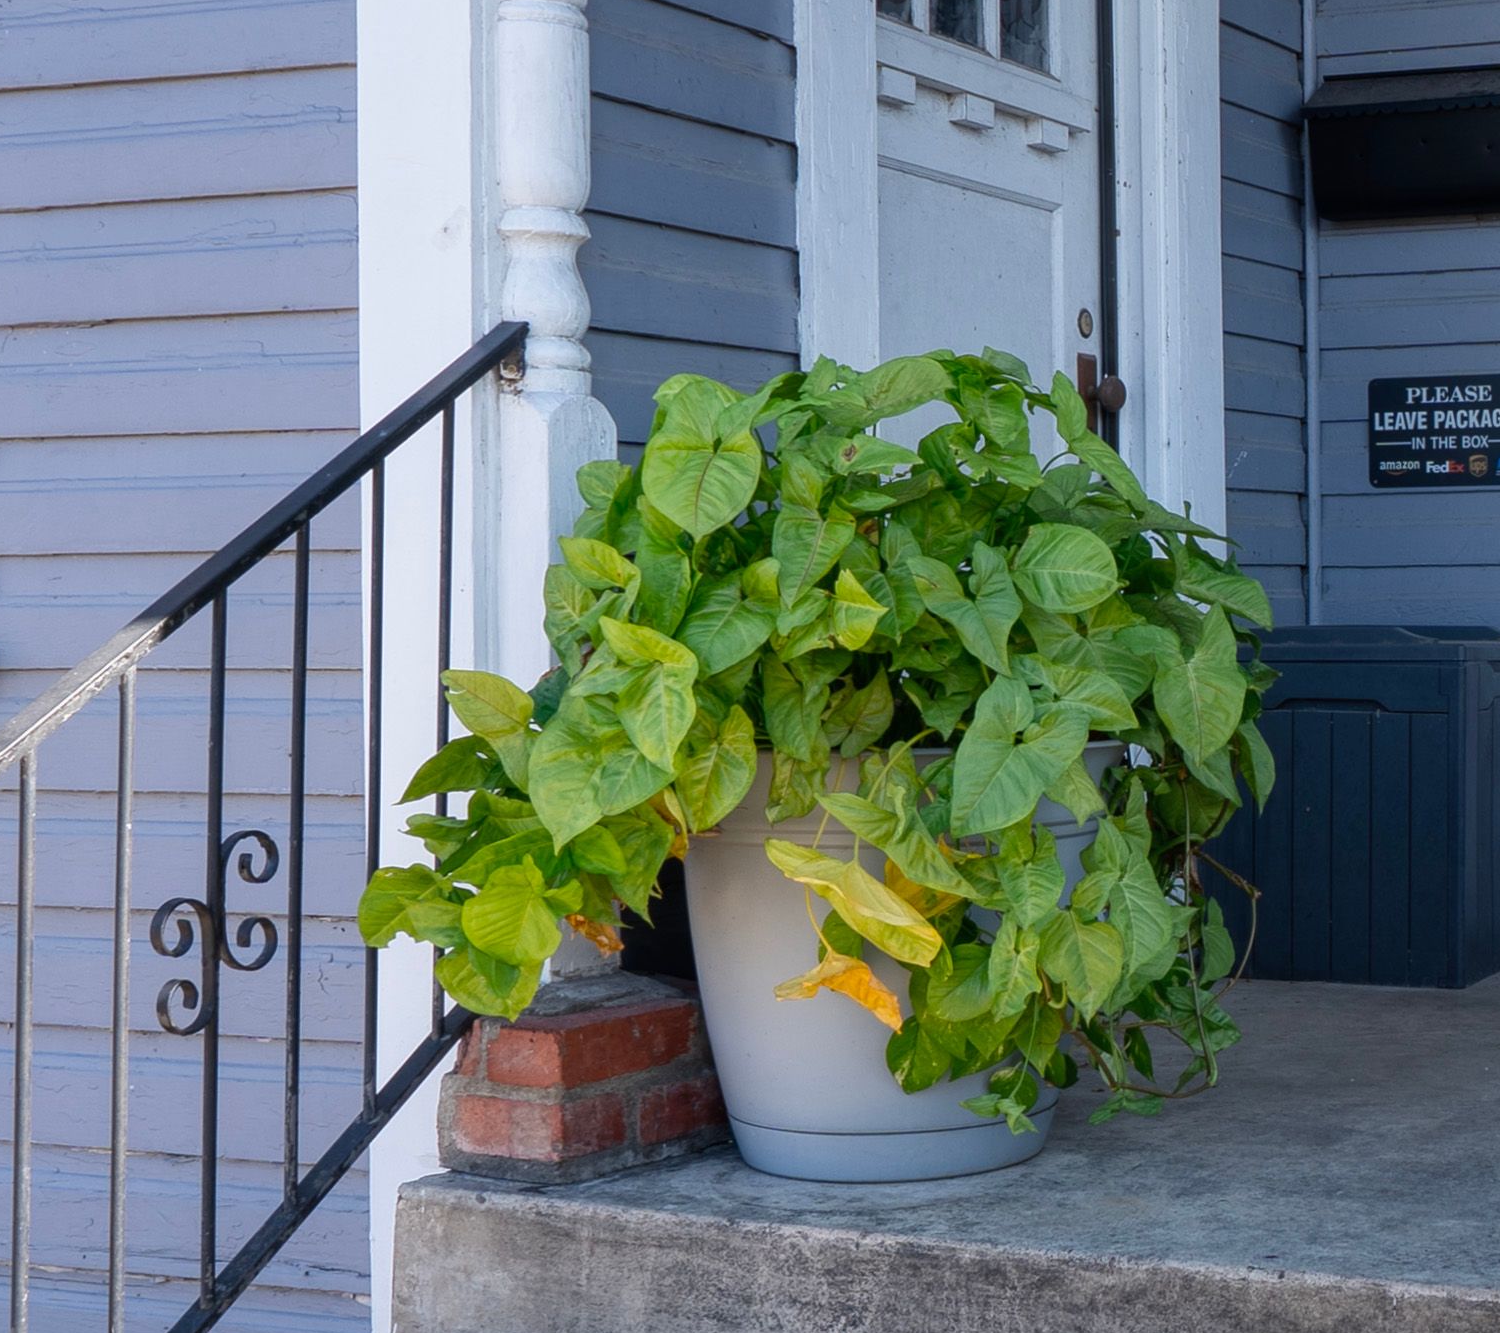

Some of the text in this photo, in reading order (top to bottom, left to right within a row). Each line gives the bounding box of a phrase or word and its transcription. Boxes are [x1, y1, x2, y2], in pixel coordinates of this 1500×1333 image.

[1406, 385, 1492, 404] PLEASE
[1374, 411, 1427, 431] LEAVE
[1412, 435, 1489, 450] IN THE BOX
[1379, 460, 1420, 471] amazon
[1426, 460, 1464, 473] FedEx
